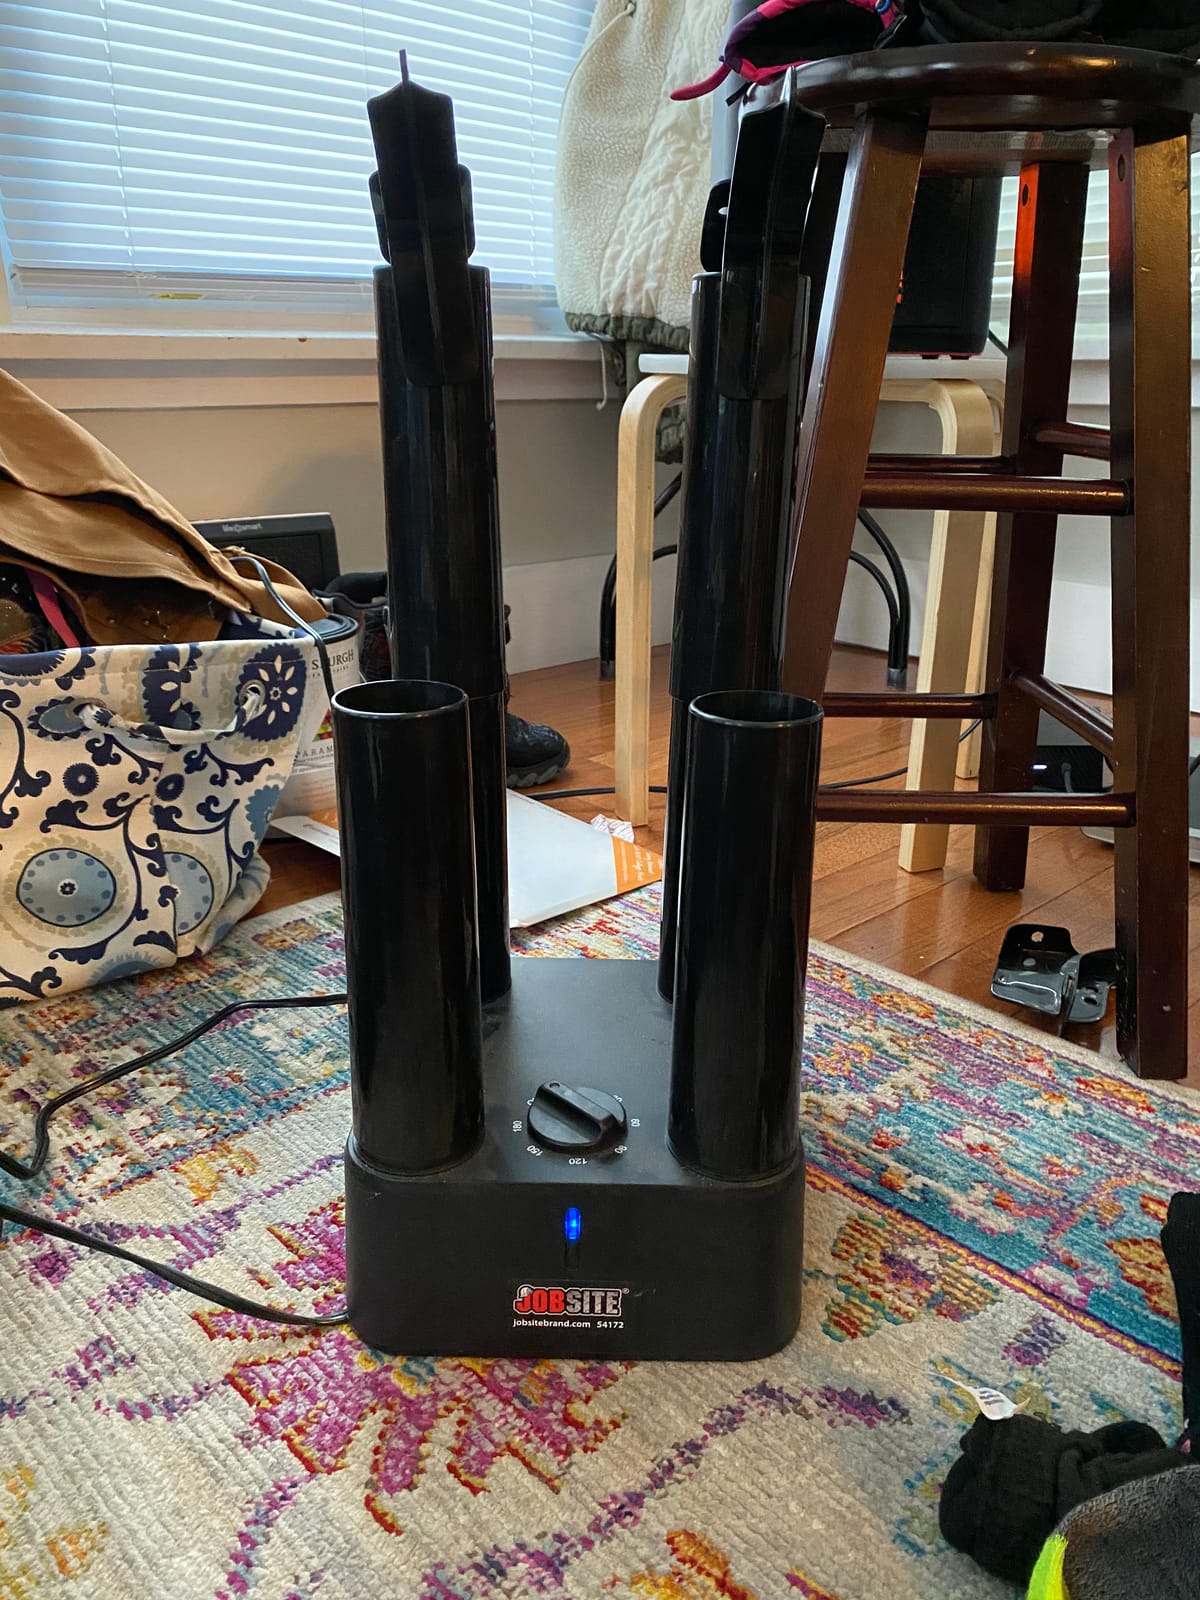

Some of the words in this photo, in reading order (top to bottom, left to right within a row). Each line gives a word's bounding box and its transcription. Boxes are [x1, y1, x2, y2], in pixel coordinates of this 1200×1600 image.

[311, 648, 354, 671] SURGH
[512, 1120, 522, 1132] 180
[526, 1144, 544, 1157] 150
[568, 1157, 588, 1165] 120
[512, 1319, 591, 1328] jobsitebrand.com
[596, 1320, 624, 1329] 54172
